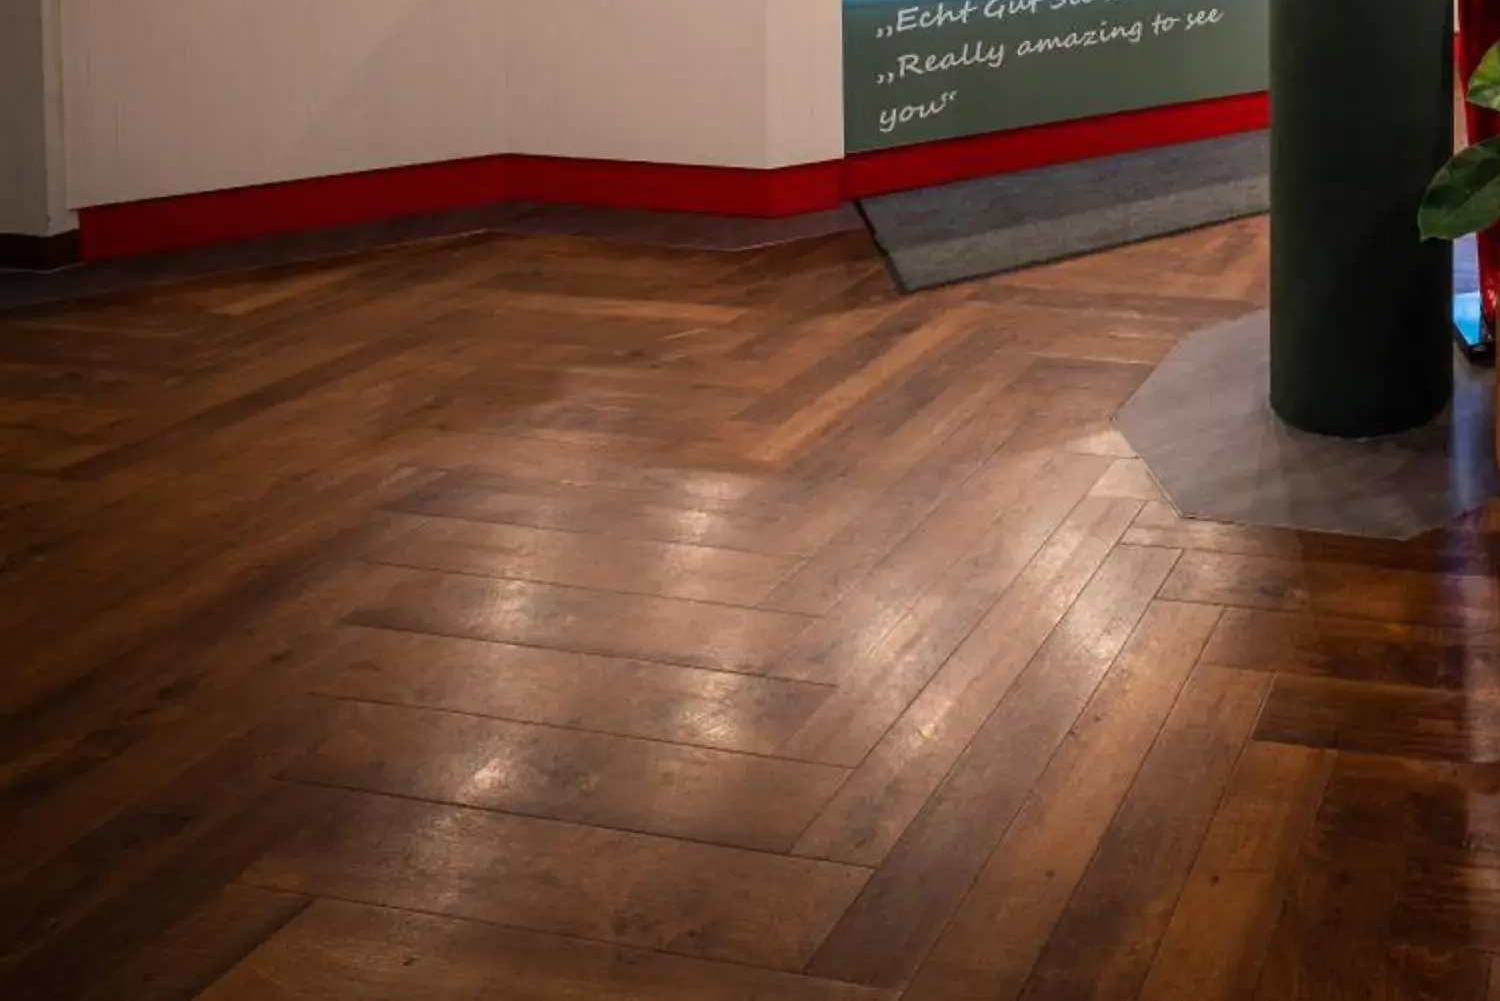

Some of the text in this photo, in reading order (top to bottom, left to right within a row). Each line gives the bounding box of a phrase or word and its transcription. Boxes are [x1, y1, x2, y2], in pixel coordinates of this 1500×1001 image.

[1016, 19, 1144, 57] amazing
[1151, 11, 1181, 36] to
[1184, 7, 1225, 31] see
